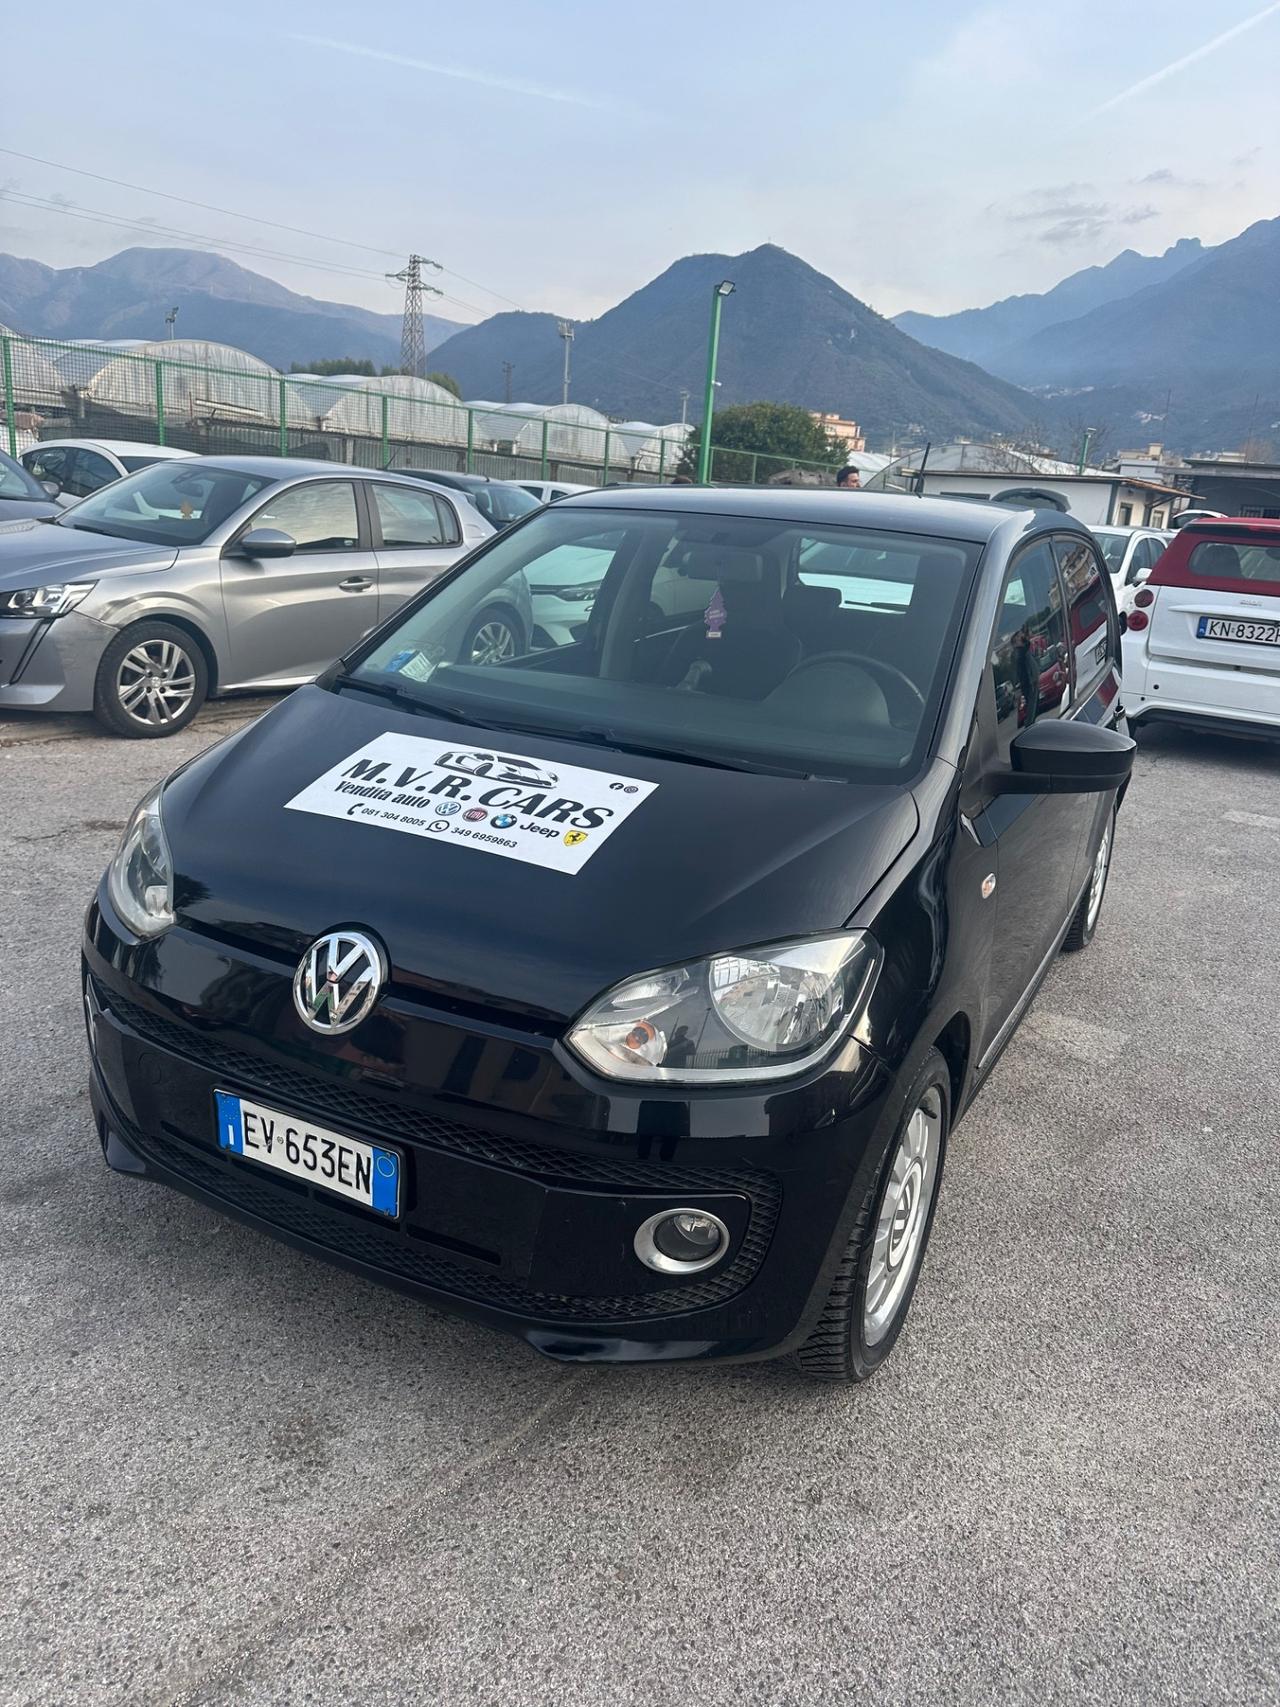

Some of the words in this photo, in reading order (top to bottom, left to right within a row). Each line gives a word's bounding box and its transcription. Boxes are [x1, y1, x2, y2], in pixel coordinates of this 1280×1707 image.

[334, 780, 393, 801] Vendita
[391, 793, 431, 809] auto
[360, 807, 380, 816] 081
[380, 810, 401, 821] 304
[400, 815, 427, 827] 8005
[450, 827, 472, 838] 349
[471, 831, 518, 849] 6959863
[519, 821, 560, 839] Jeep
